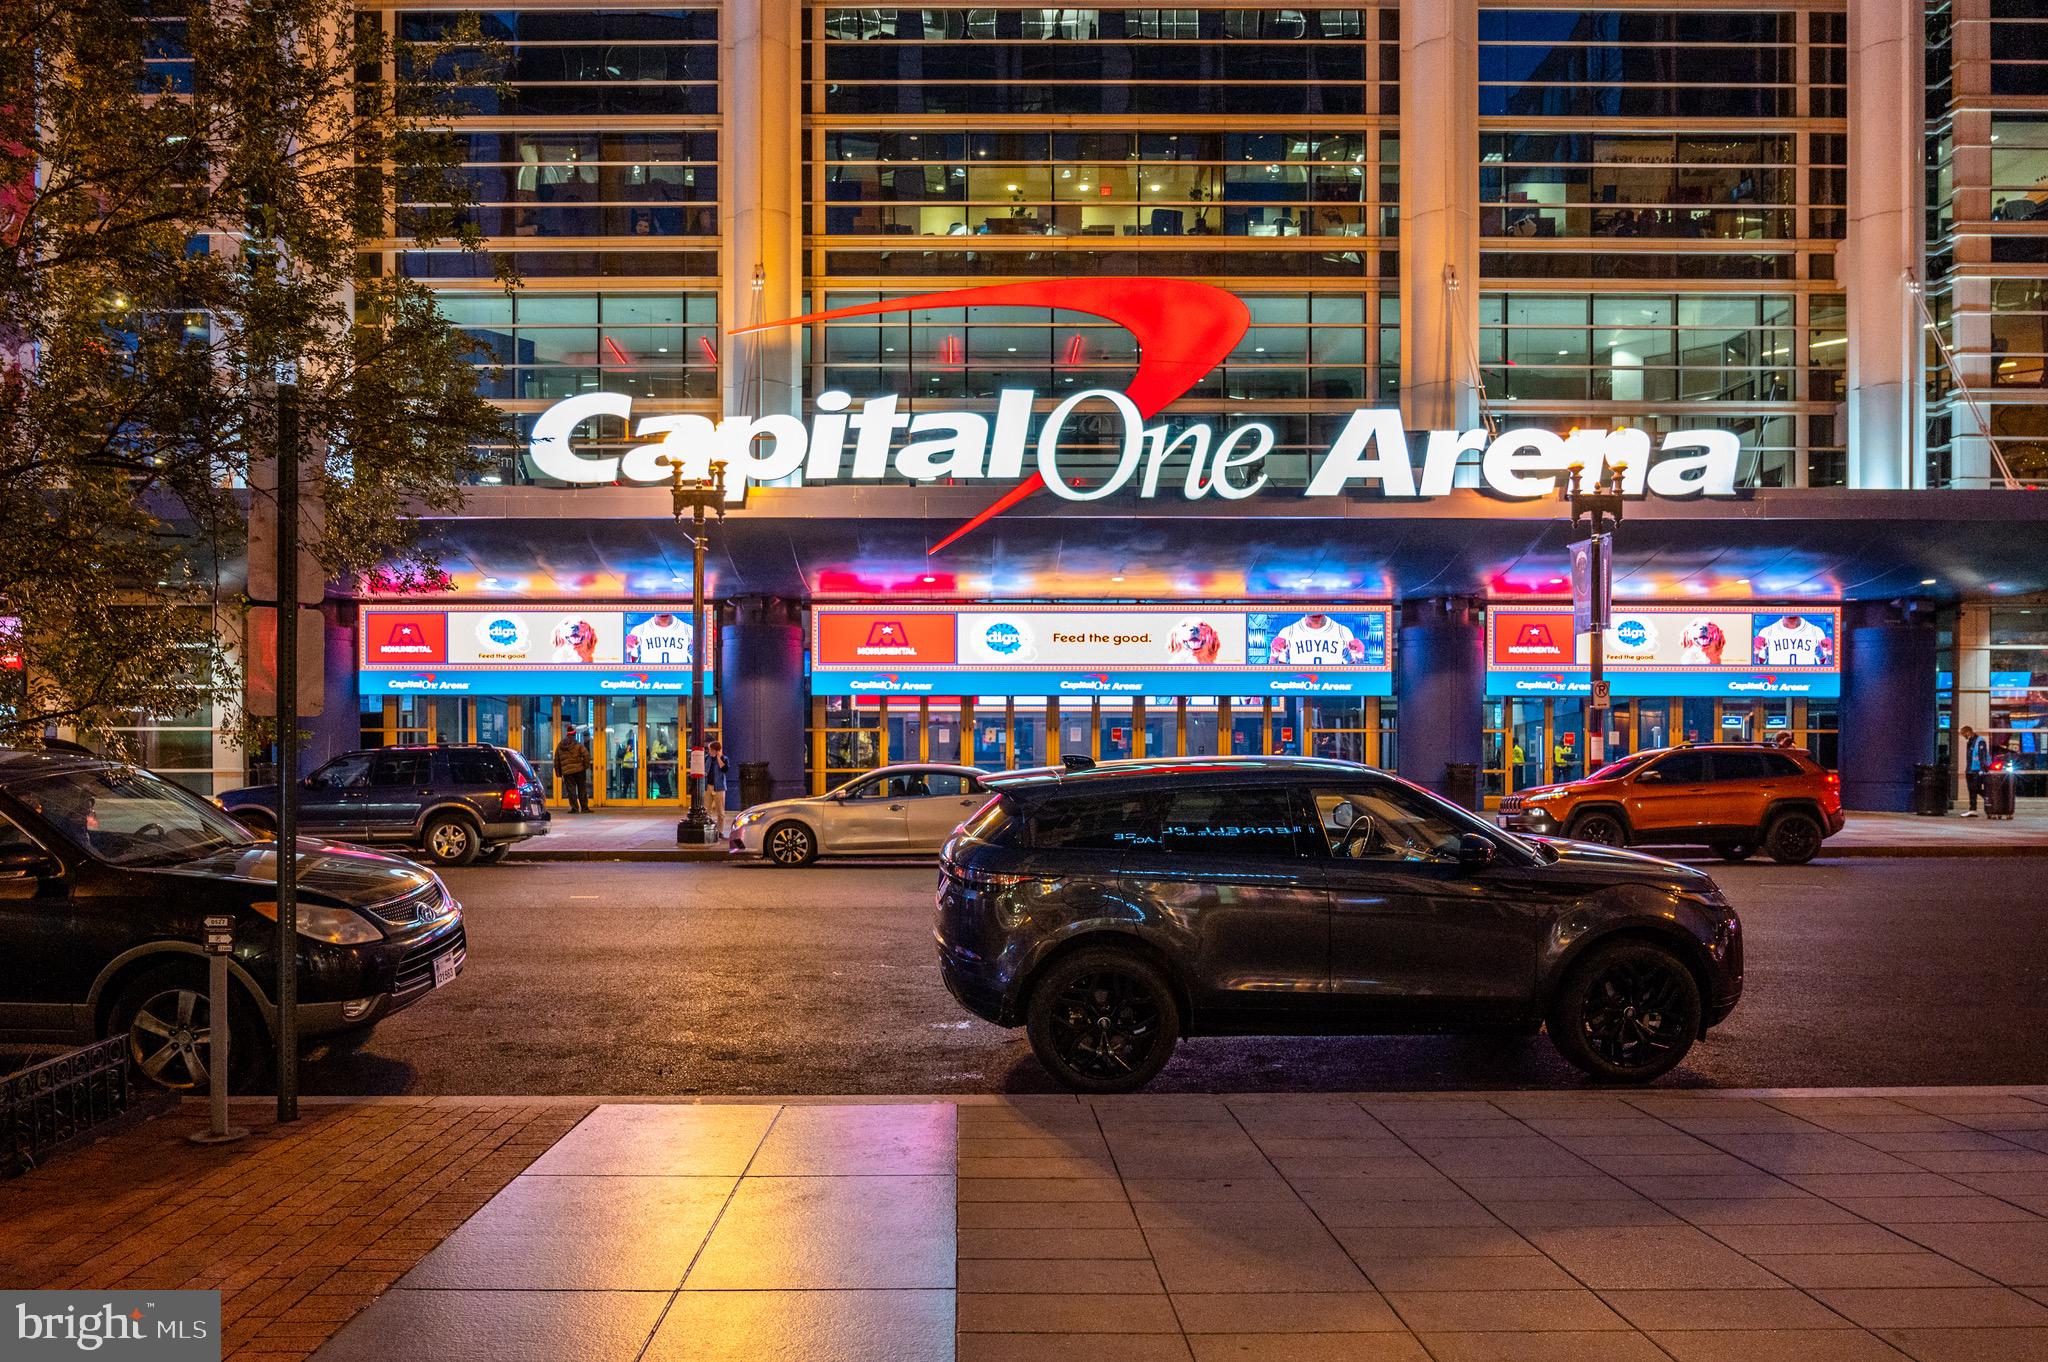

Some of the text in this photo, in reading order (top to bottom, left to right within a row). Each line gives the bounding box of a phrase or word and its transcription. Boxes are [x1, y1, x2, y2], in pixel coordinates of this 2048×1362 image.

[1304, 409, 1741, 497] Arena
[646, 636, 684, 650] HOYAS
[1053, 633, 1152, 646] Feed the good.
[381, 645, 432, 653] MONUMENTAL
[1296, 639, 1339, 655] HOYAS
[1773, 638, 1812, 652] HOYAS
[856, 647, 917, 656] MONUMENTAL
[1508, 646, 1561, 654] MONUMENTAL
[440, 681, 470, 690] Arena
[652, 681, 683, 690] Arena
[901, 681, 932, 690] Arena
[1112, 682, 1143, 691] Arena
[1321, 682, 1353, 691] Arena
[1567, 682, 1591, 691] Aren
[1779, 683, 1809, 691] Arena
